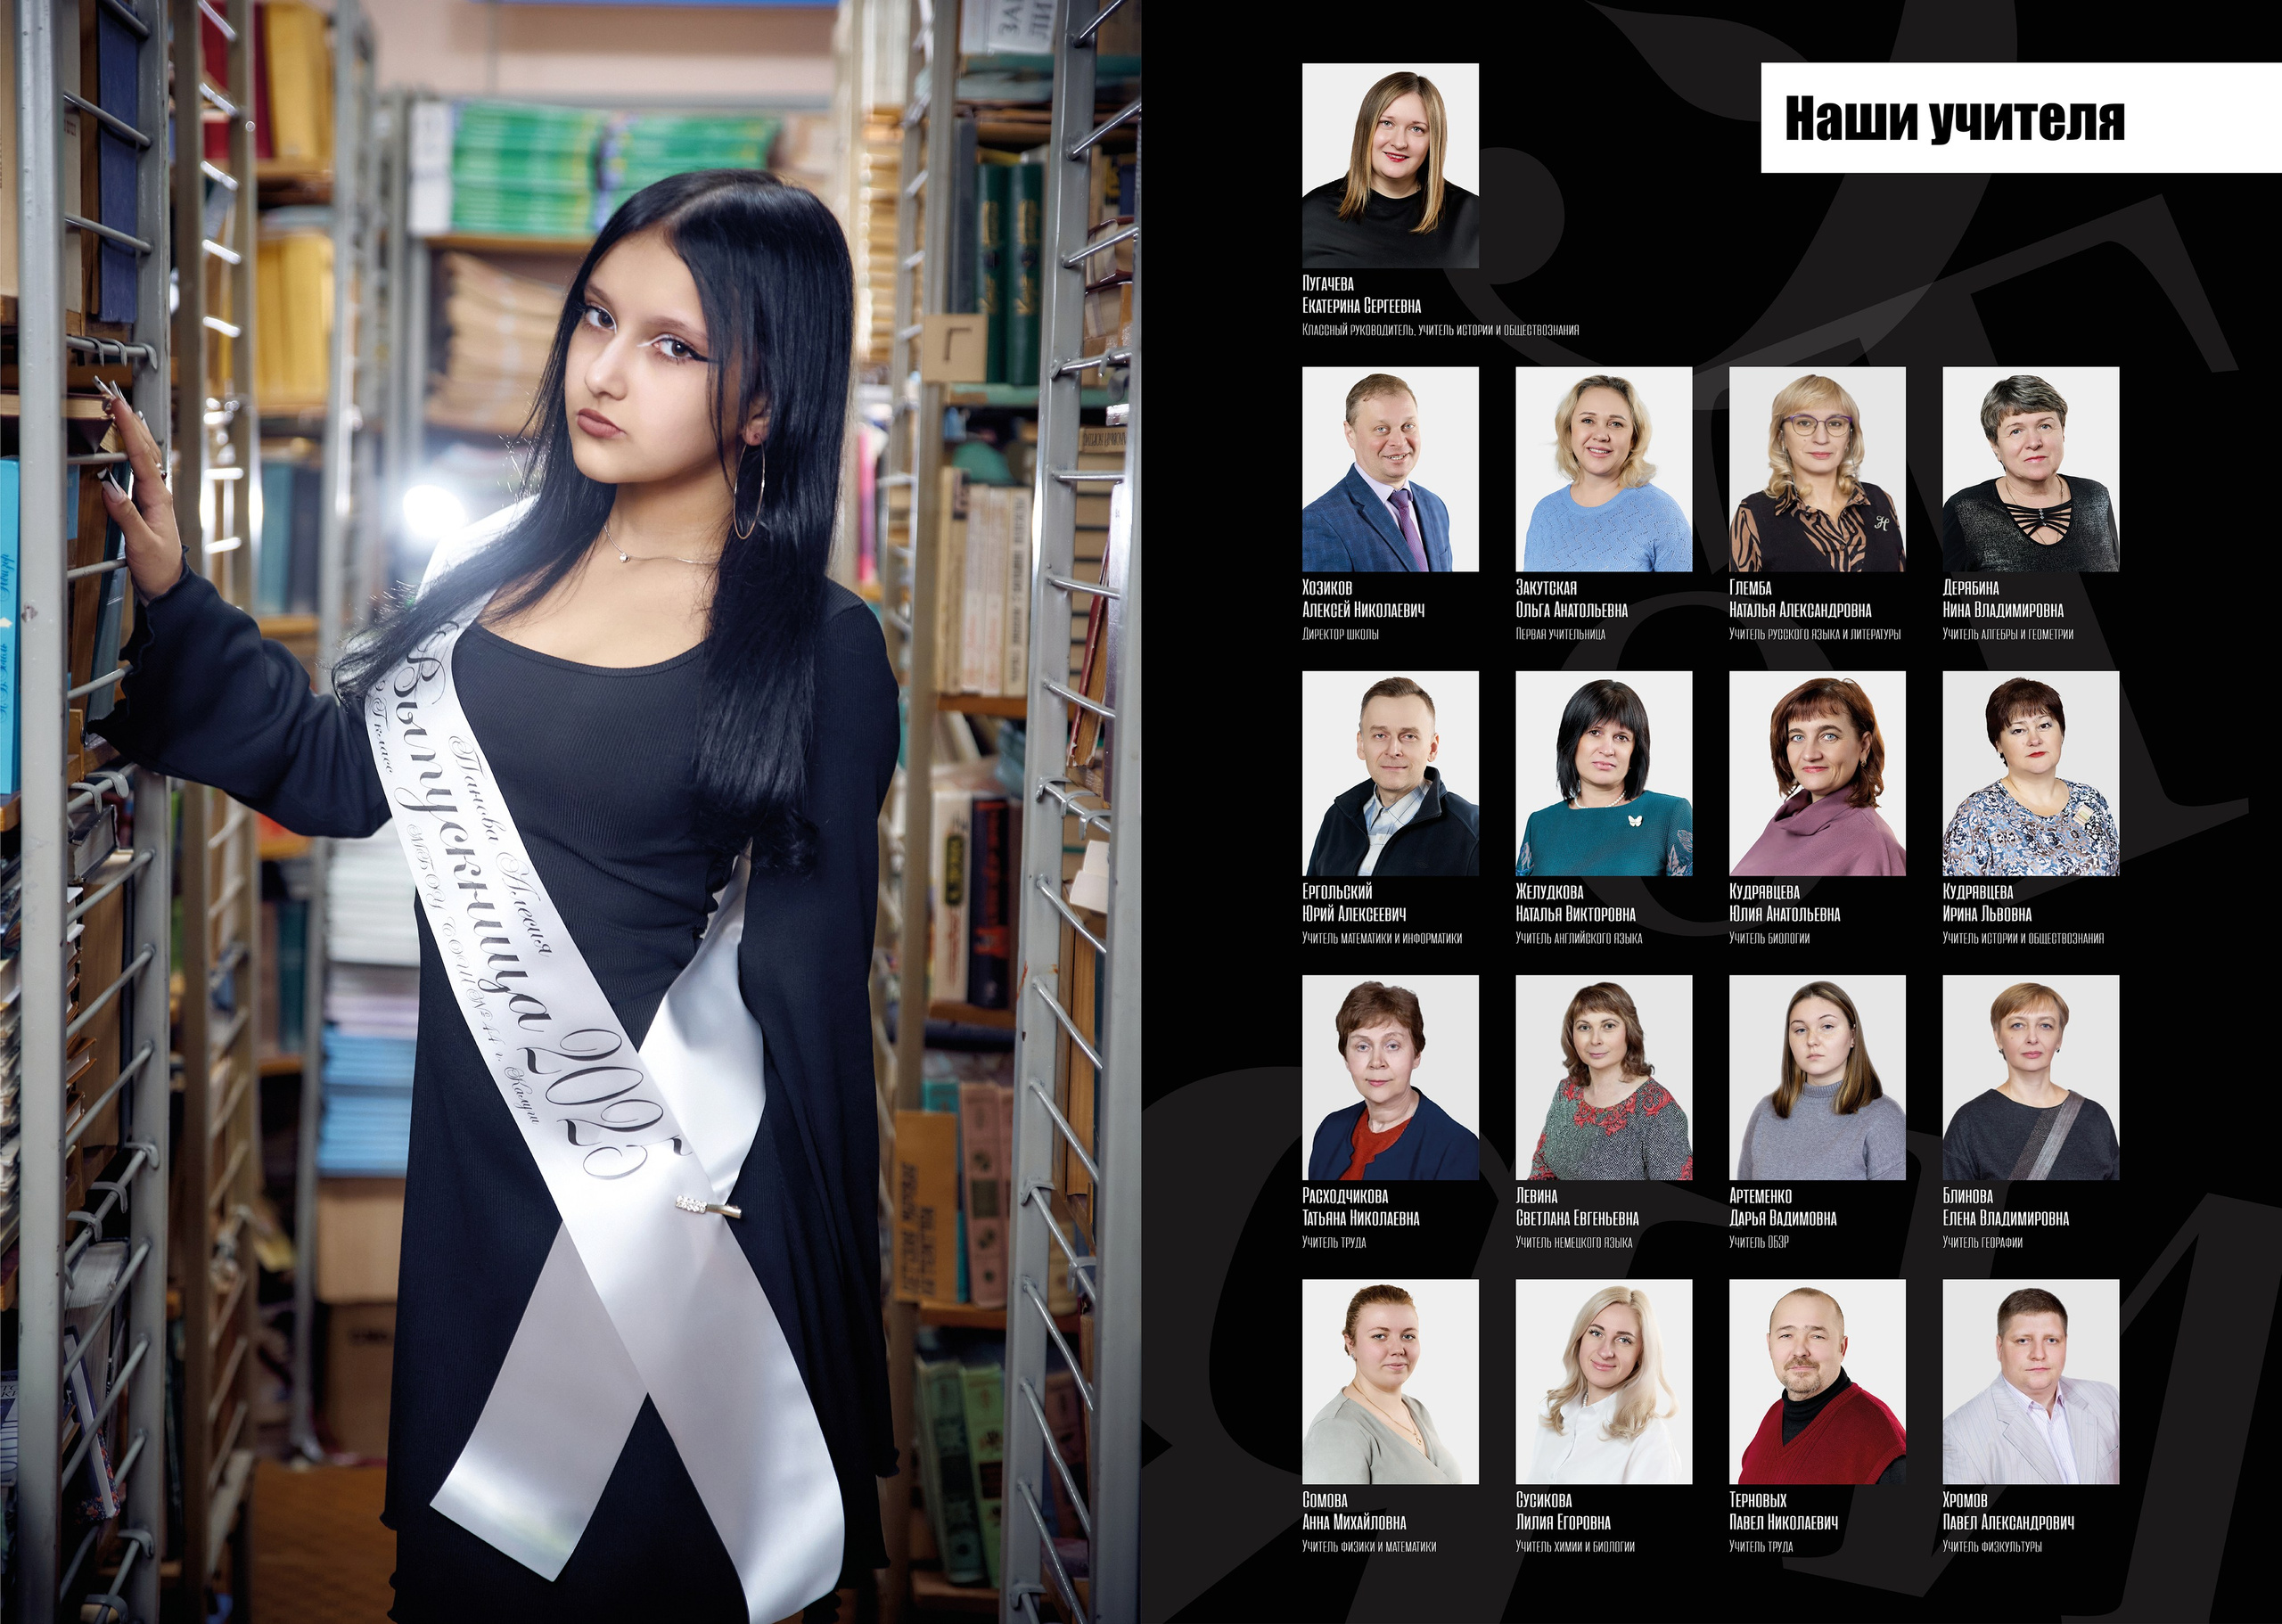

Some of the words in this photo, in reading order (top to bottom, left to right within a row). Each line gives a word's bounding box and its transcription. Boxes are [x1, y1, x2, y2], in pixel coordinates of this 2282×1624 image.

[1786, 95, 1918, 142] Наши
[1928, 103, 2125, 146] учителя
[393, 620, 553, 1033] Выпускница
[516, 1028, 693, 1181] 2025
[504, 1066, 540, 1126] Калуги
